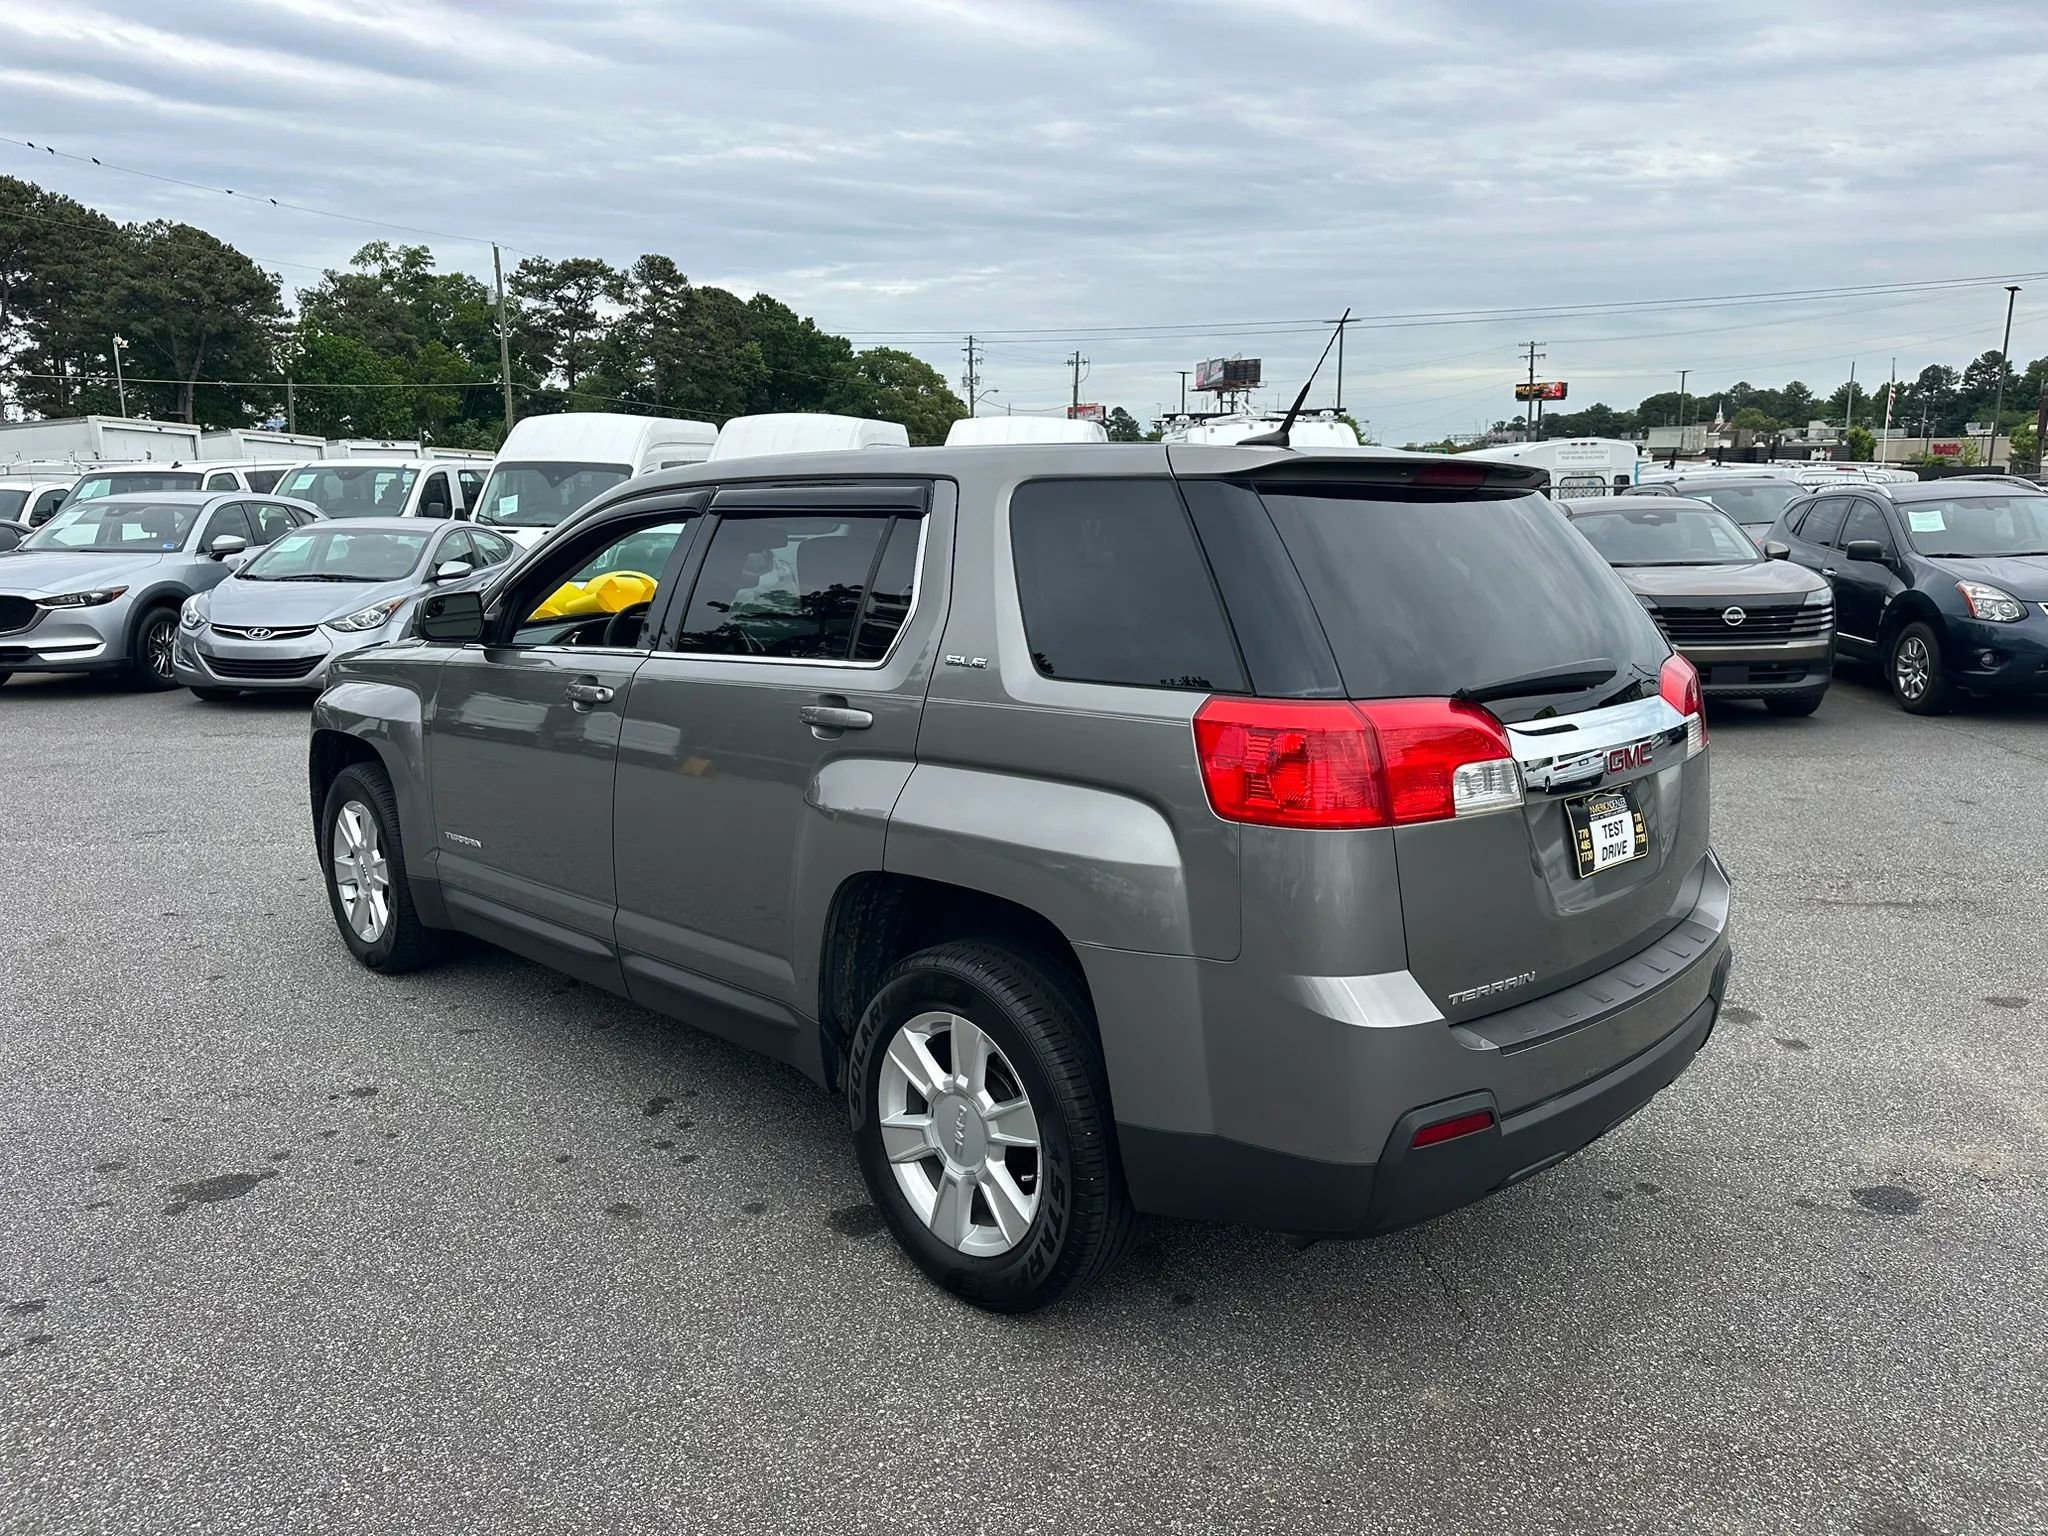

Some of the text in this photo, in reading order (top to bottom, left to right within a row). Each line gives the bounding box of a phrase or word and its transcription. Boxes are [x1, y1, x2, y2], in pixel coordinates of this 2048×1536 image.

[945, 654, 988, 669] SLE
[1607, 740, 1653, 773] GMC
[1602, 820, 1624, 839] TEST
[1602, 840, 1628, 861] DRIVE
[1448, 970, 1536, 1006] TERRAIN
[850, 990, 890, 1117] SOLAR
